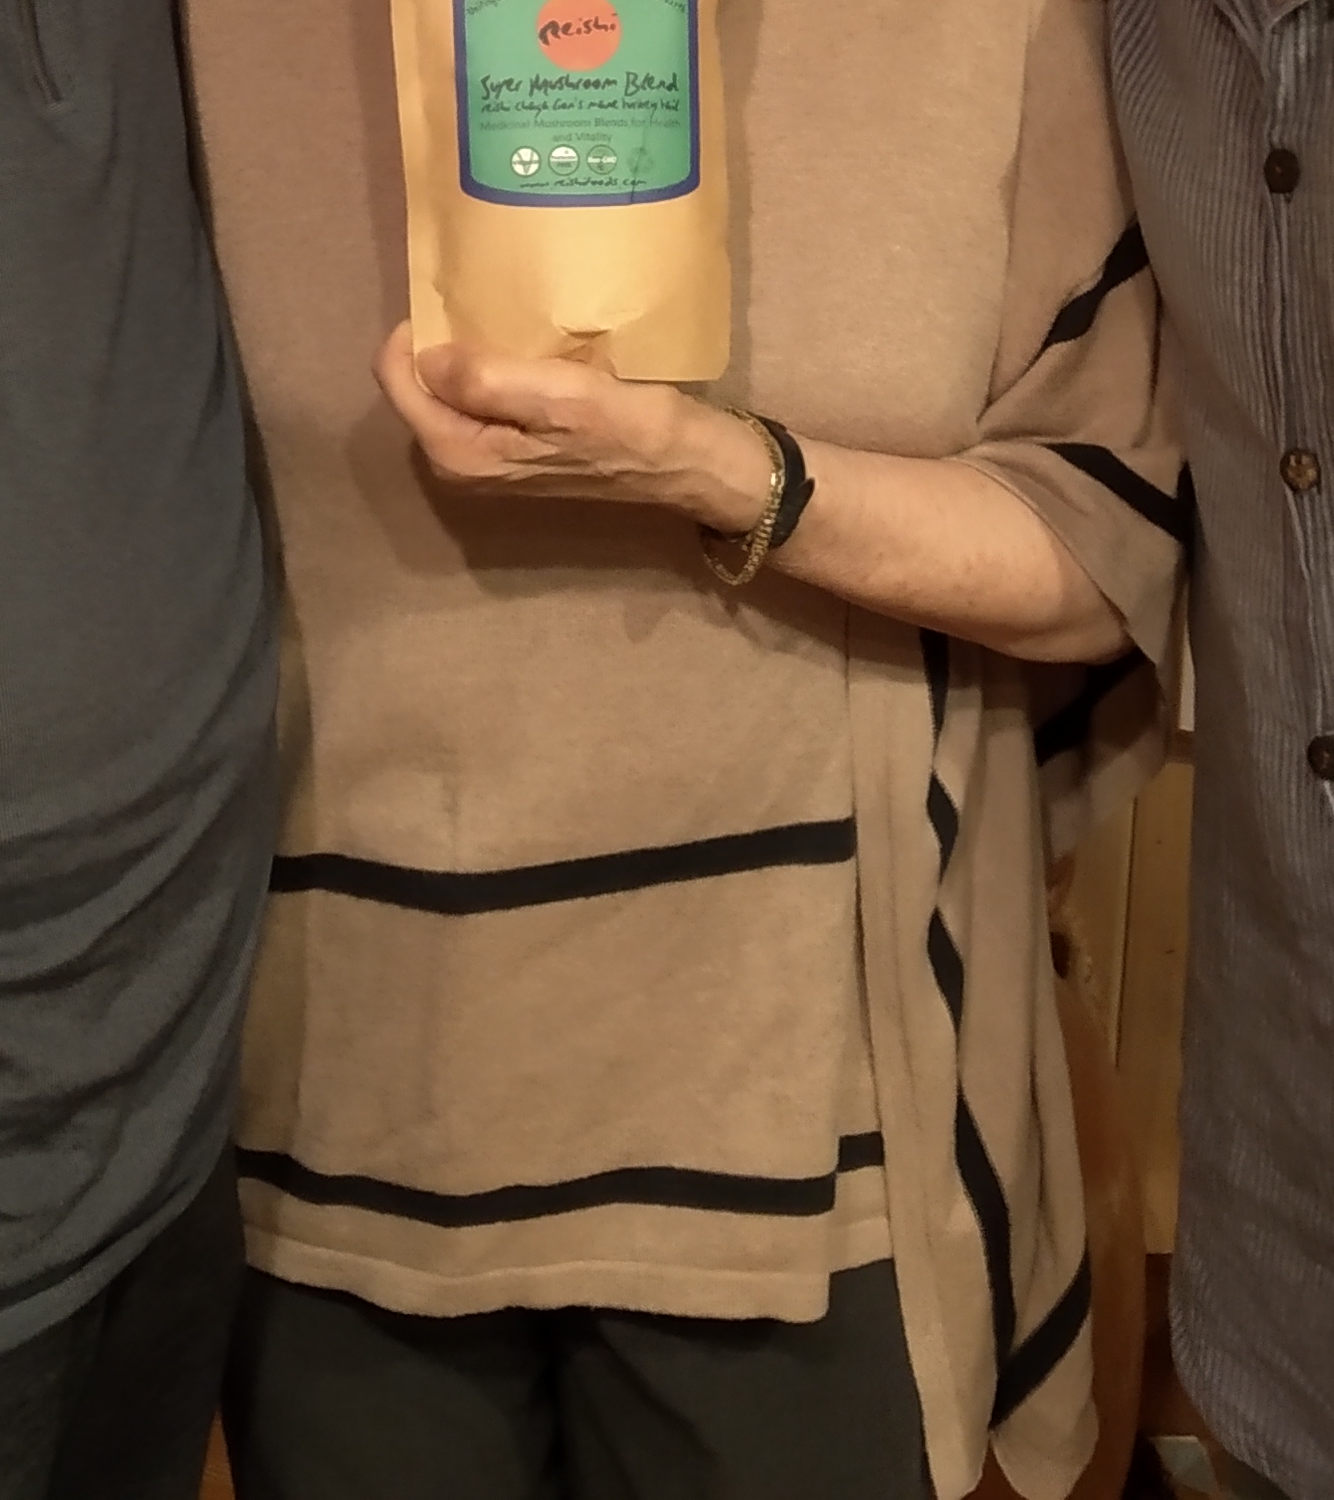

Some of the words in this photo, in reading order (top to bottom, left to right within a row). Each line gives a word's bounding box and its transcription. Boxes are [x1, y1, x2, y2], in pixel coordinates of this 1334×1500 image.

[480, 74, 523, 100] Super
[528, 73, 618, 98] Mushroom
[624, 71, 679, 97] Blend
[534, 118, 592, 130] Mushroom
[593, 117, 628, 129] Blends
[552, 132, 573, 142] and
[576, 131, 613, 143] Vitality
